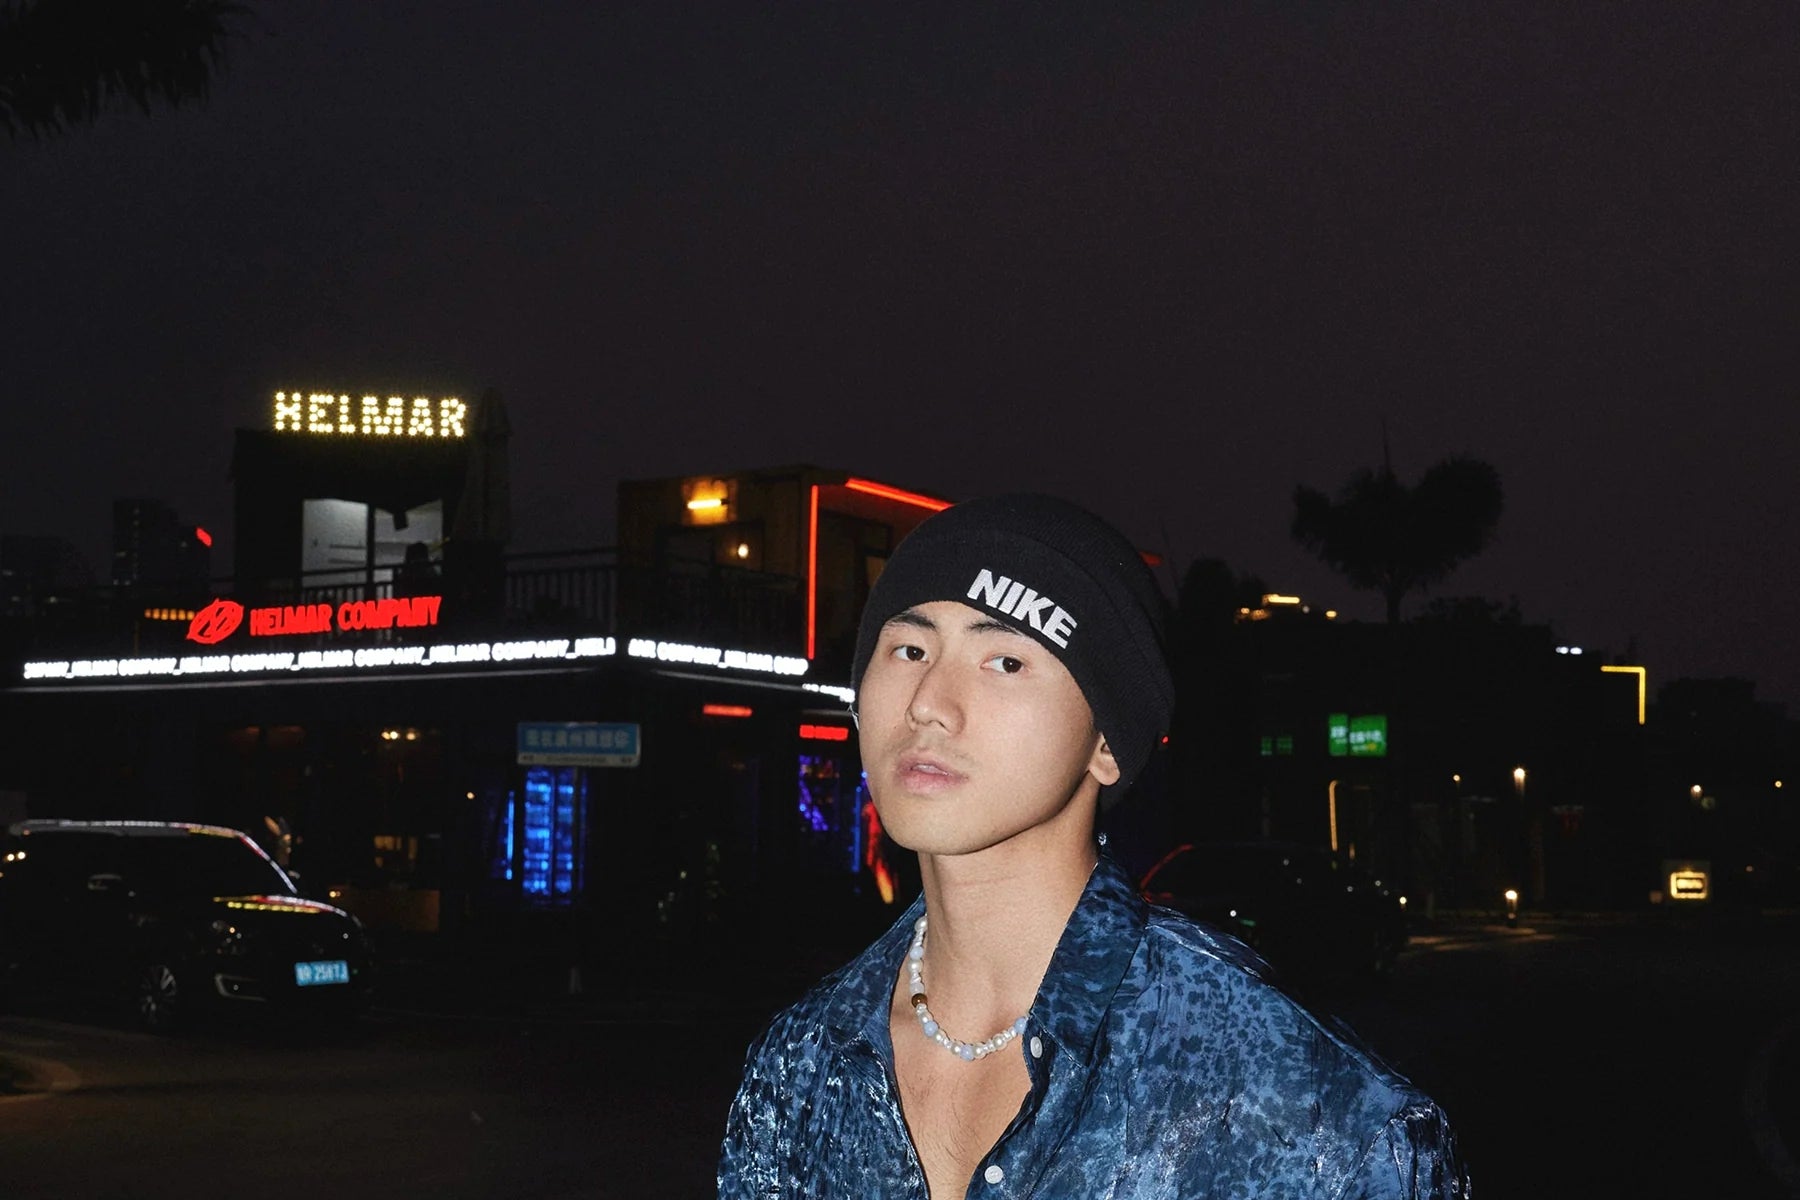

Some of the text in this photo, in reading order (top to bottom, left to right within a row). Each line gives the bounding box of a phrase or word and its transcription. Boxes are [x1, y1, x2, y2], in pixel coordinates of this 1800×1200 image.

[273, 391, 467, 437] HELMAR
[250, 596, 442, 636] HELMAR COMPANY
[966, 568, 1078, 649] NIKE
